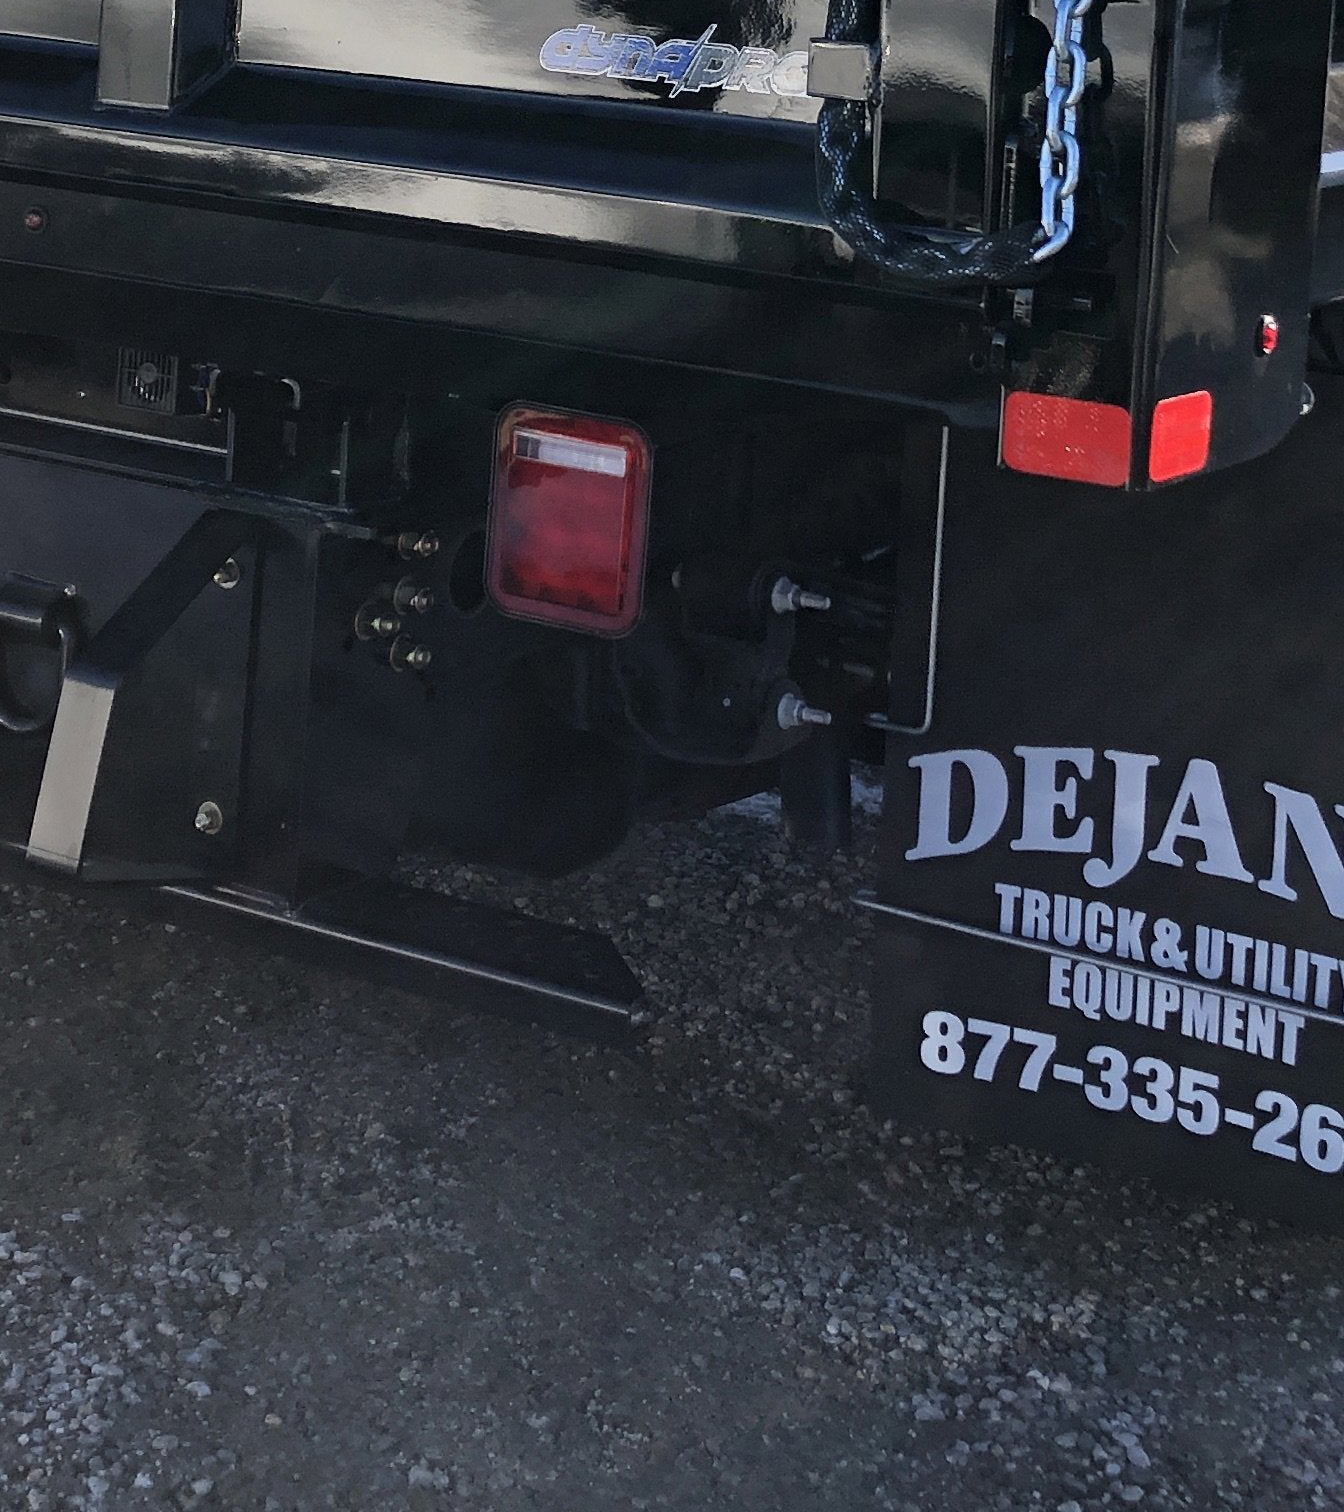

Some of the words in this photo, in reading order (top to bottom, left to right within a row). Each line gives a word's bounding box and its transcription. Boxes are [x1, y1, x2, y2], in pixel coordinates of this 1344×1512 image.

[994, 882, 1147, 963] TRUCK
[1150, 917, 1188, 973] &
[1047, 954, 1305, 1067] EQUIPMENT
